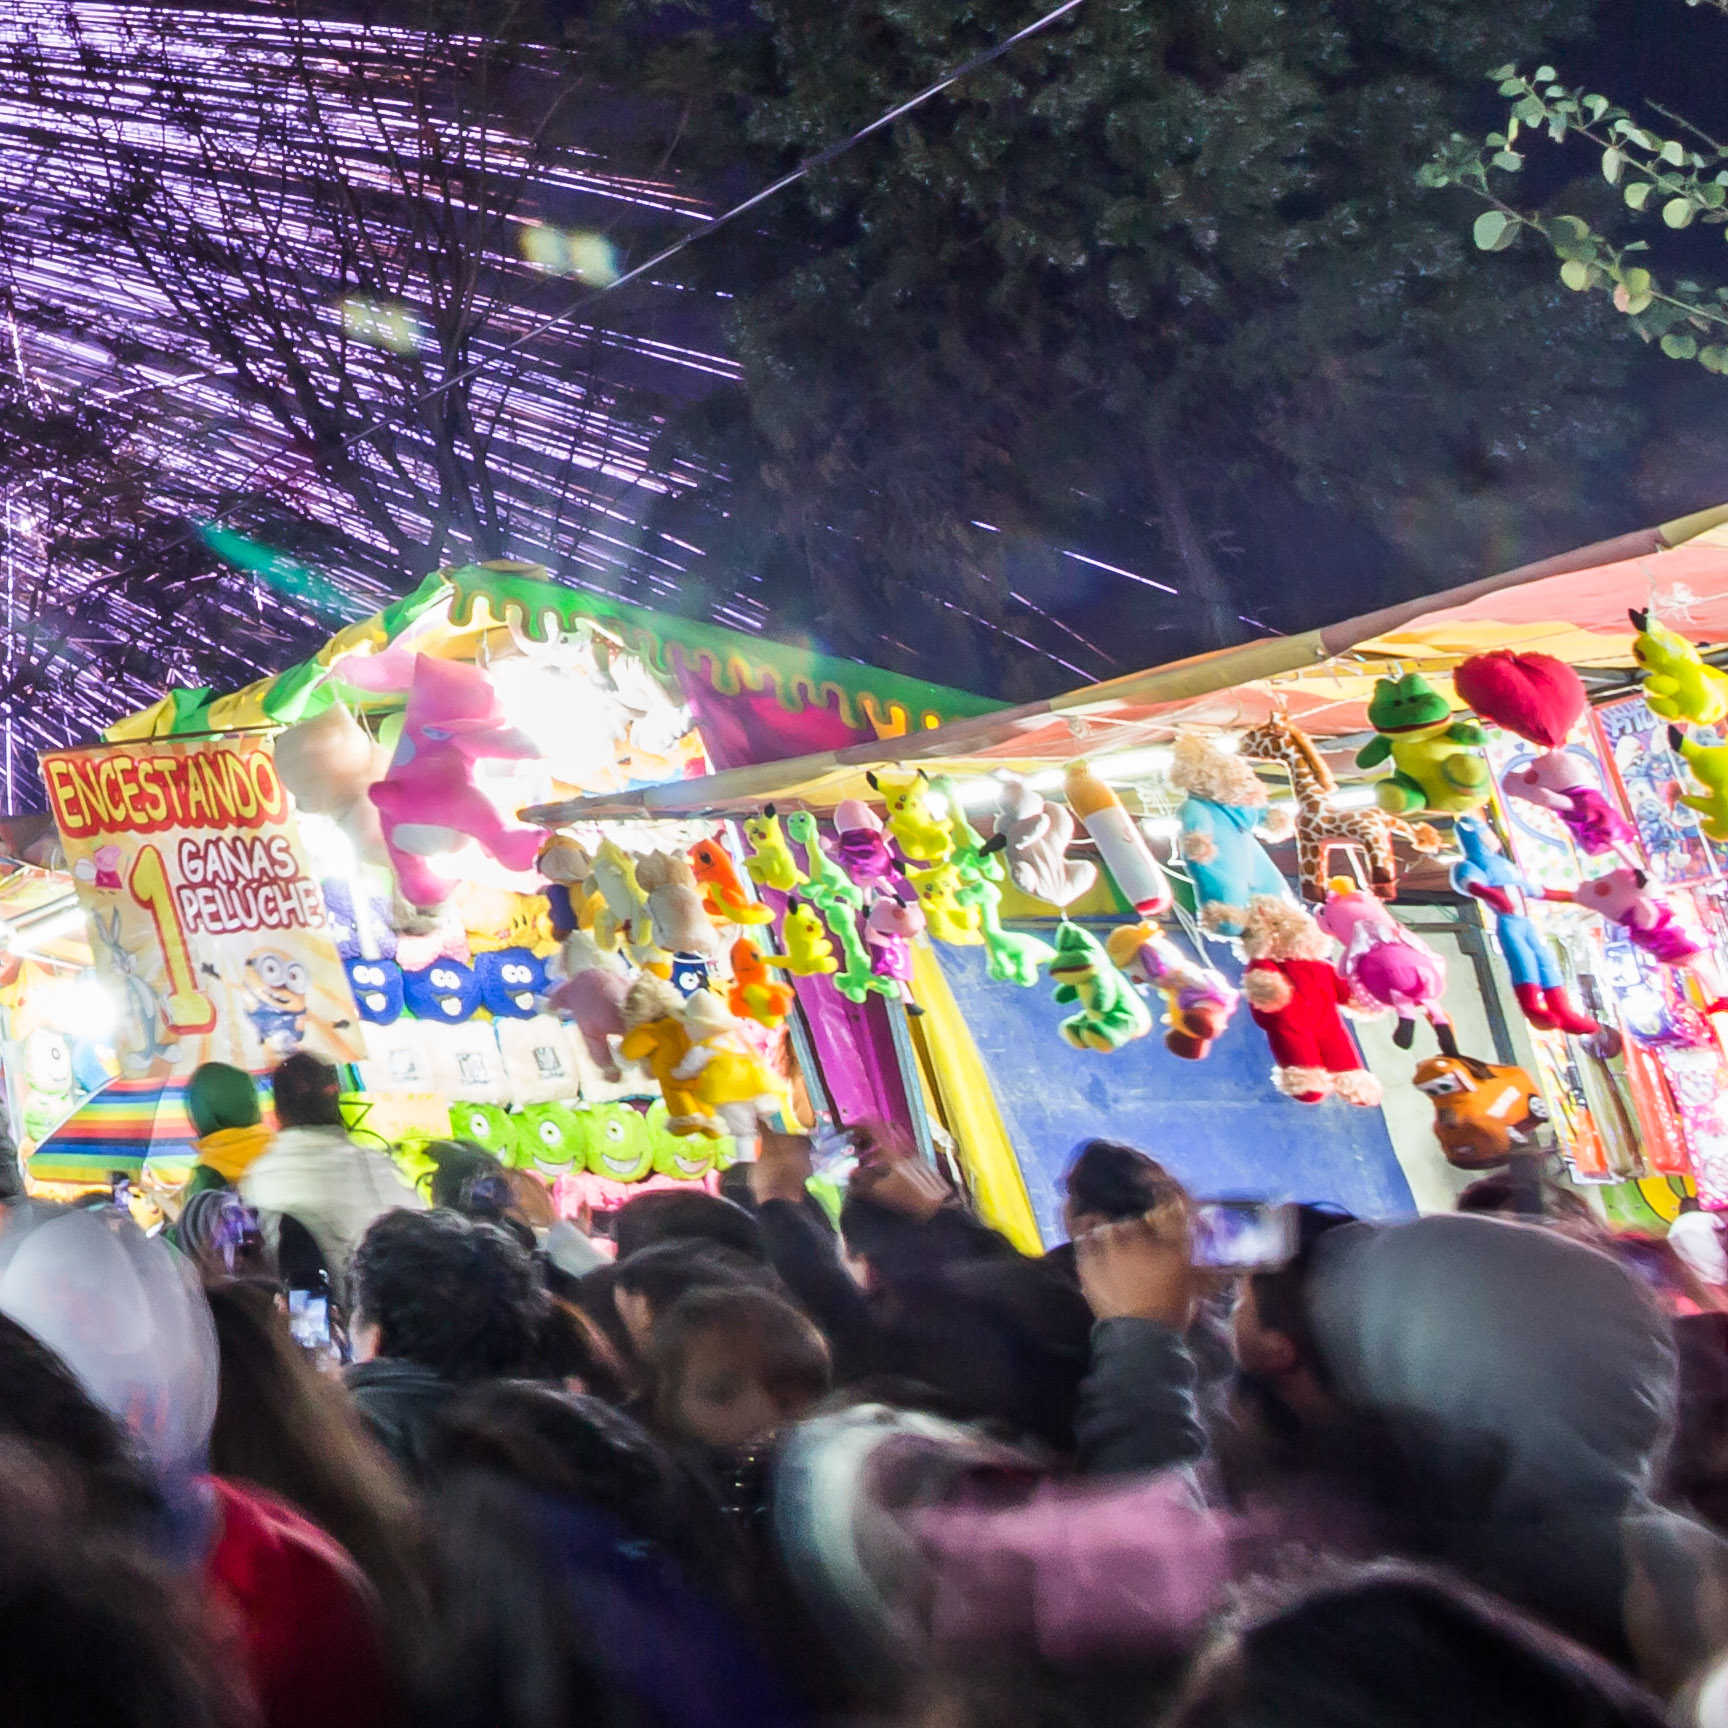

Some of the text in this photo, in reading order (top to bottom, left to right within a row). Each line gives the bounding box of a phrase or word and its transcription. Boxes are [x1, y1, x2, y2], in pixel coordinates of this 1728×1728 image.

[46, 751, 282, 830] ENCESTANDO
[179, 836, 297, 882] GANAS
[178, 878, 324, 932] PELUCHE
[130, 845, 216, 1033] 1
